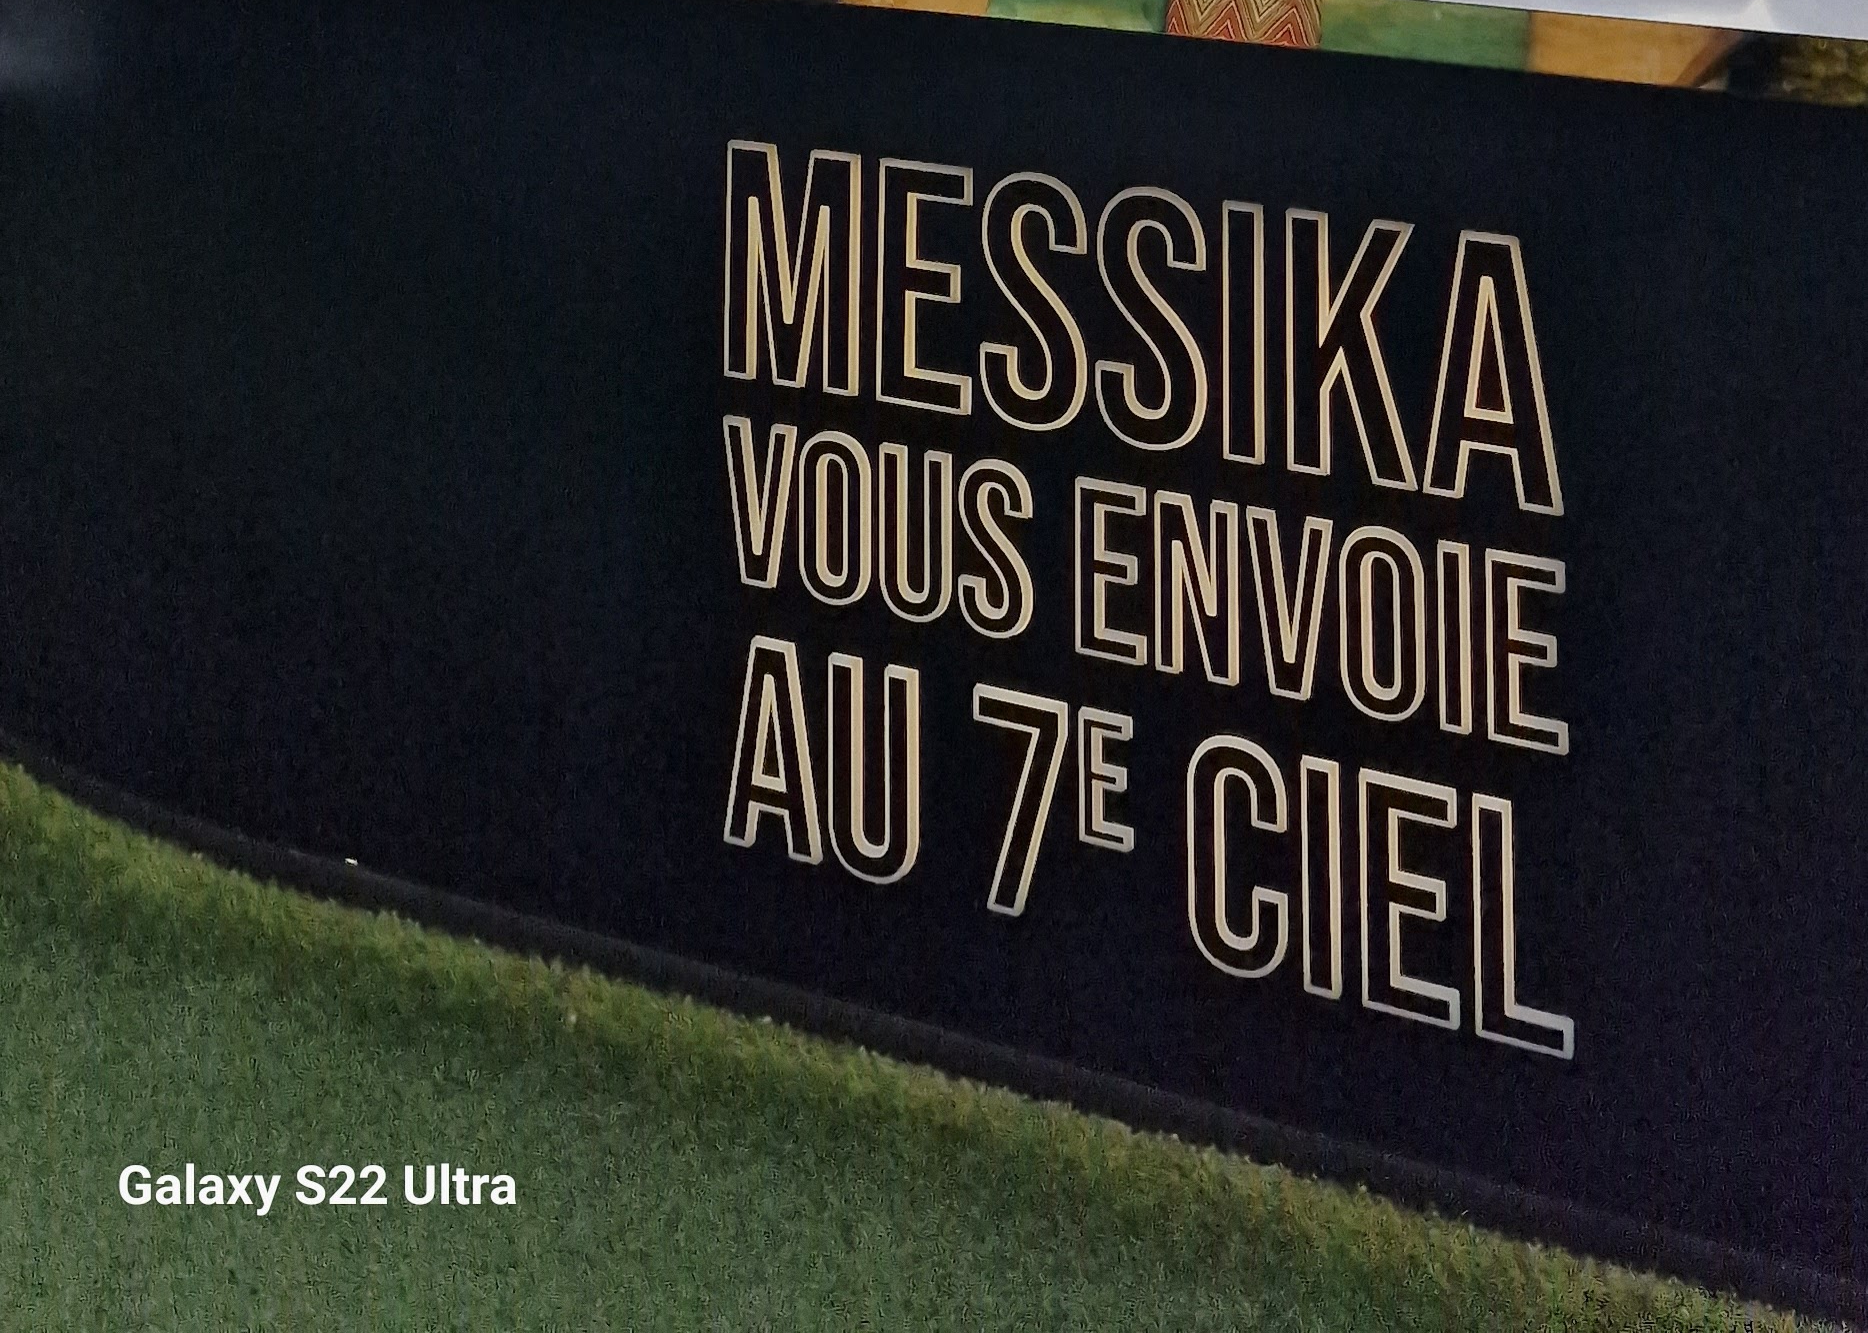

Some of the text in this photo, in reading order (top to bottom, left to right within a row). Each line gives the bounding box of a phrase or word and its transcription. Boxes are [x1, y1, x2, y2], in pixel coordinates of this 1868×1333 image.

[723, 139, 1565, 516] MESSIKA
[722, 414, 1570, 756] VOUS ENVOIE
[723, 634, 921, 885] AU
[1185, 733, 1576, 1060] CIEL
